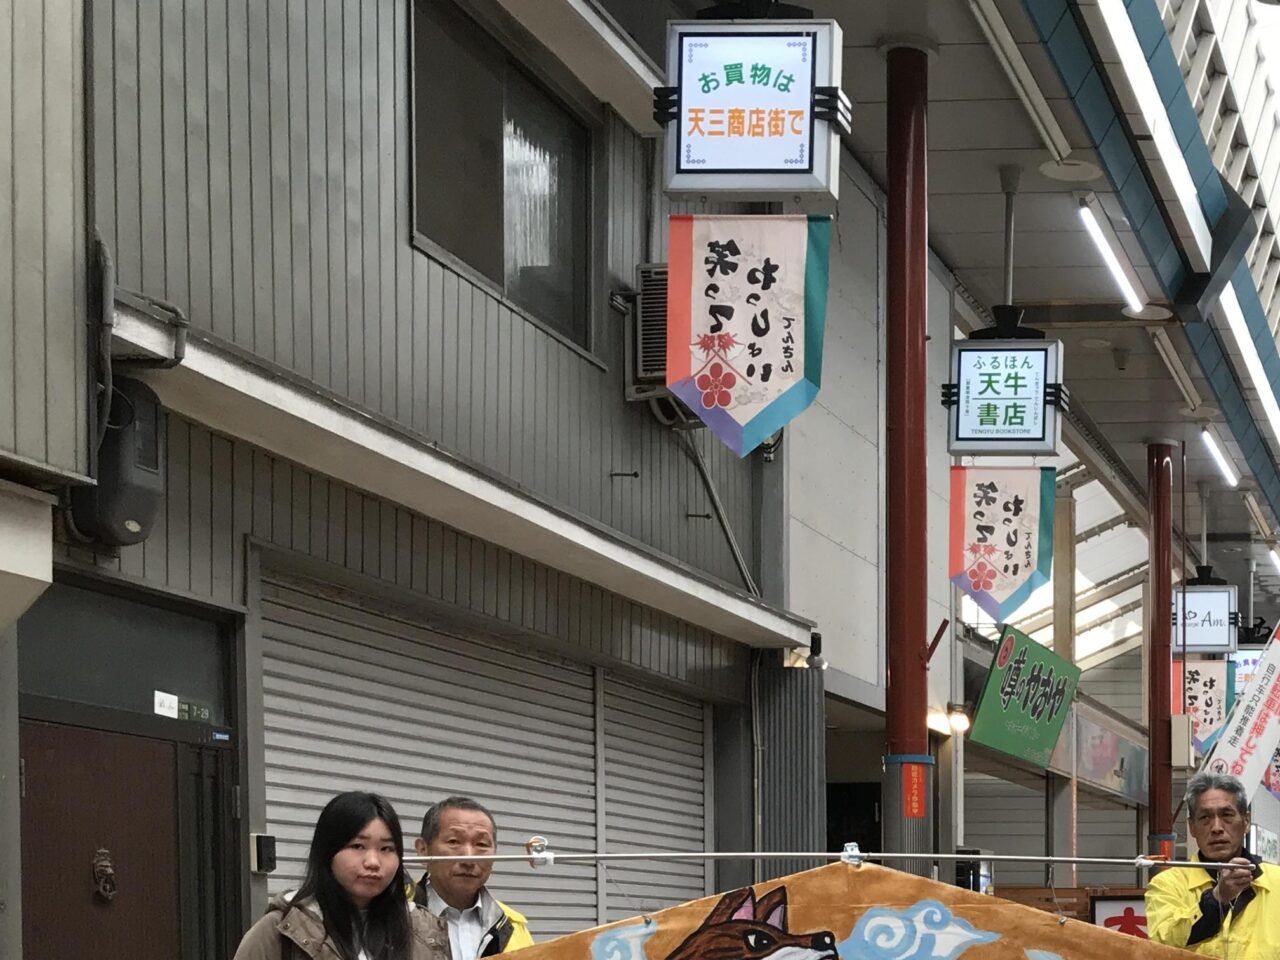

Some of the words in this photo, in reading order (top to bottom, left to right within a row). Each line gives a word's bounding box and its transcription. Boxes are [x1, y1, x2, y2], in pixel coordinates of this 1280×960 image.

[697, 62, 796, 94] お買物は
[687, 107, 805, 137] 天三商店街で
[973, 356, 1034, 369] ふるほん
[978, 372, 1028, 395] 天牛
[977, 402, 1026, 426] 書店
